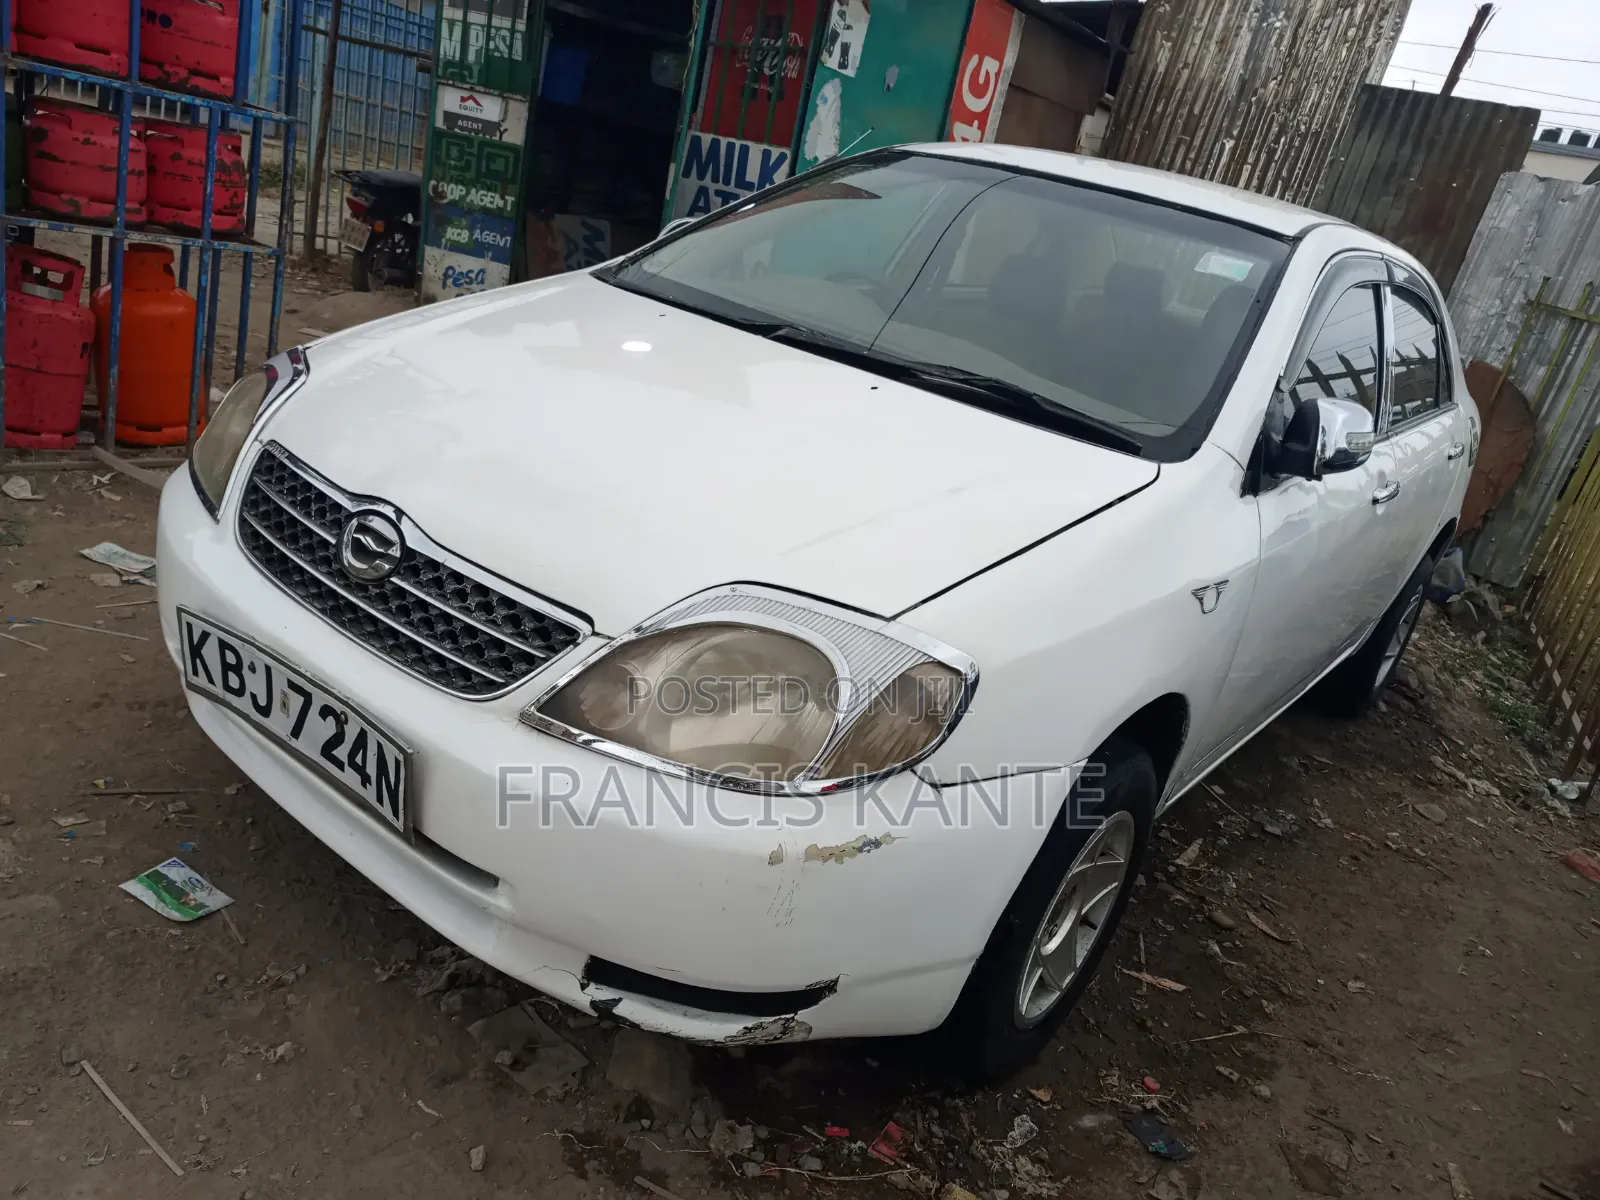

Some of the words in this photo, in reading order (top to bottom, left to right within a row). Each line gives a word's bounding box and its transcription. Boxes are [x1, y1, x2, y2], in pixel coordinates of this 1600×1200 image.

[459, 103, 484, 114] EQUITY
[457, 119, 483, 131] AGENT
[681, 134, 788, 193] MILK
[465, 187, 516, 212] AGENT
[472, 228, 512, 248] AGENT
[441, 265, 487, 290] Pesa
[185, 620, 274, 719] KBJ
[286, 677, 402, 821] 724N
